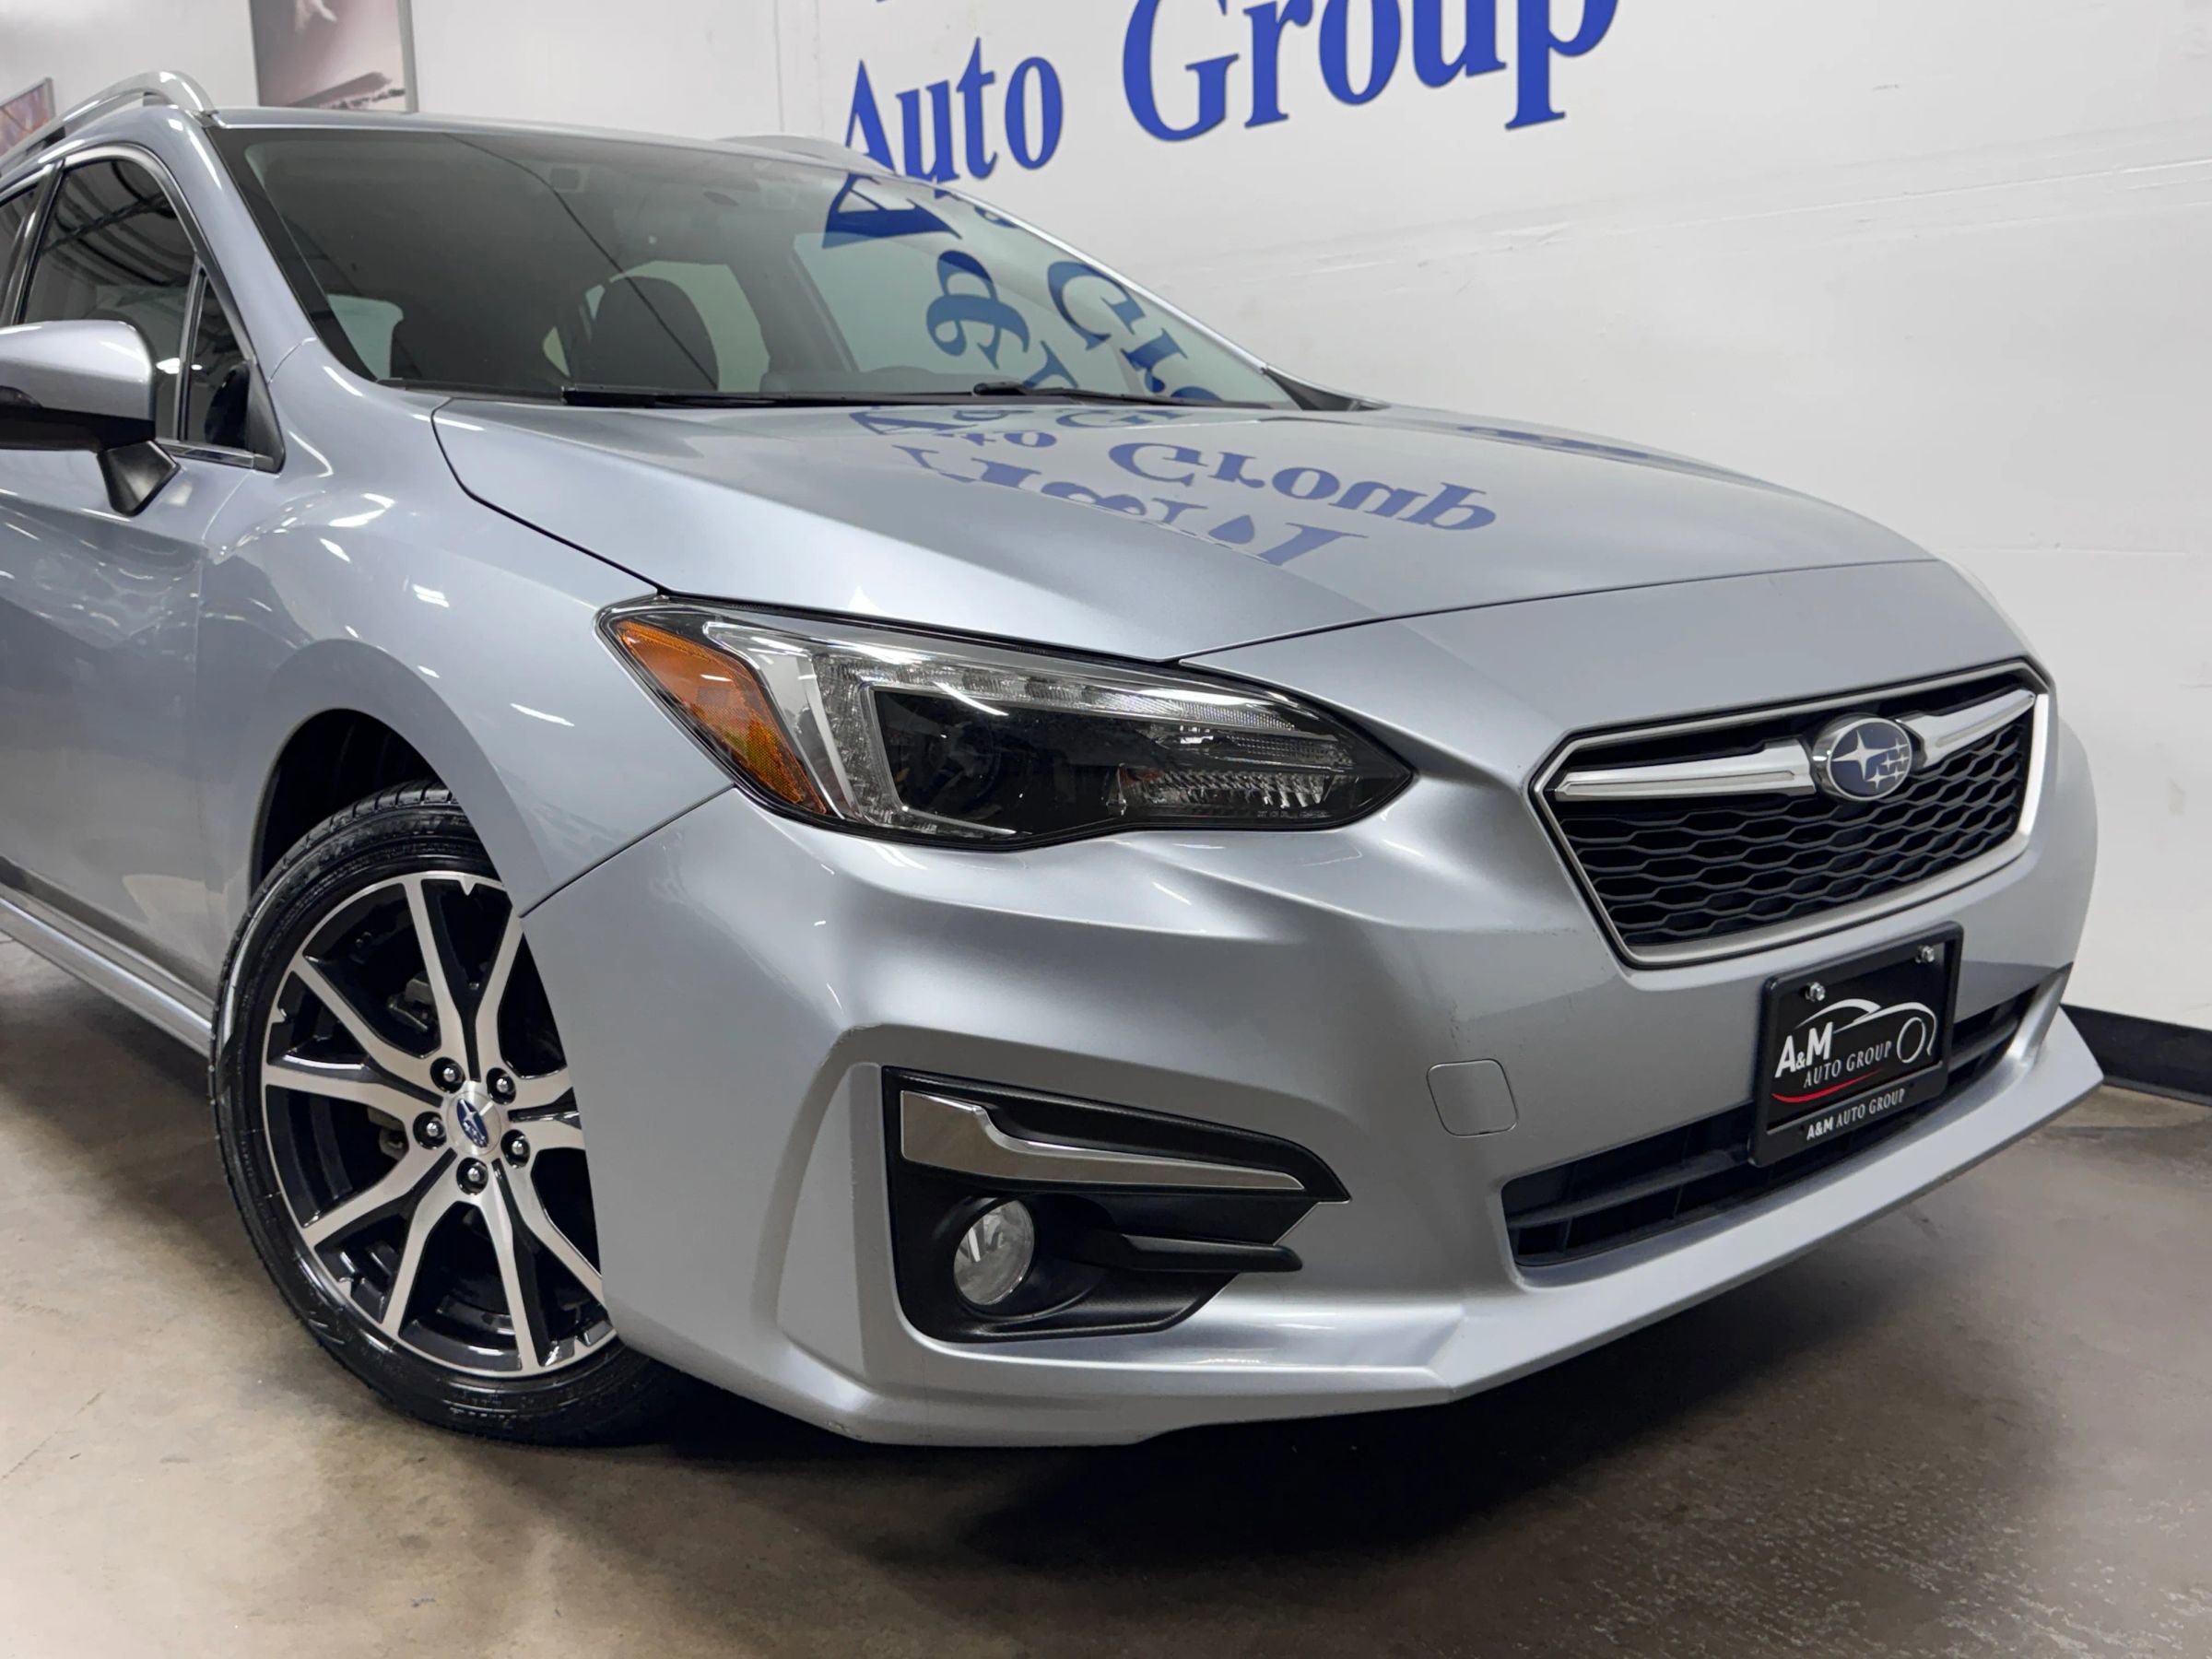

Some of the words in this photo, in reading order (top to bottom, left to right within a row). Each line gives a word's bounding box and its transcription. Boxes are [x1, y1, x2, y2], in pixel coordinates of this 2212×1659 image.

[844, 36, 1064, 183] Auto
[1122, 0, 1619, 142] Group
[1774, 1021, 1834, 1078] A&M
[1803, 1059, 1841, 1088] AUTO
[1846, 1040, 1892, 1073] GROUP
[1806, 1116, 1834, 1141] A&M
[1836, 1103, 1865, 1128] AUTO
[1868, 1088, 1906, 1115] GROUP
